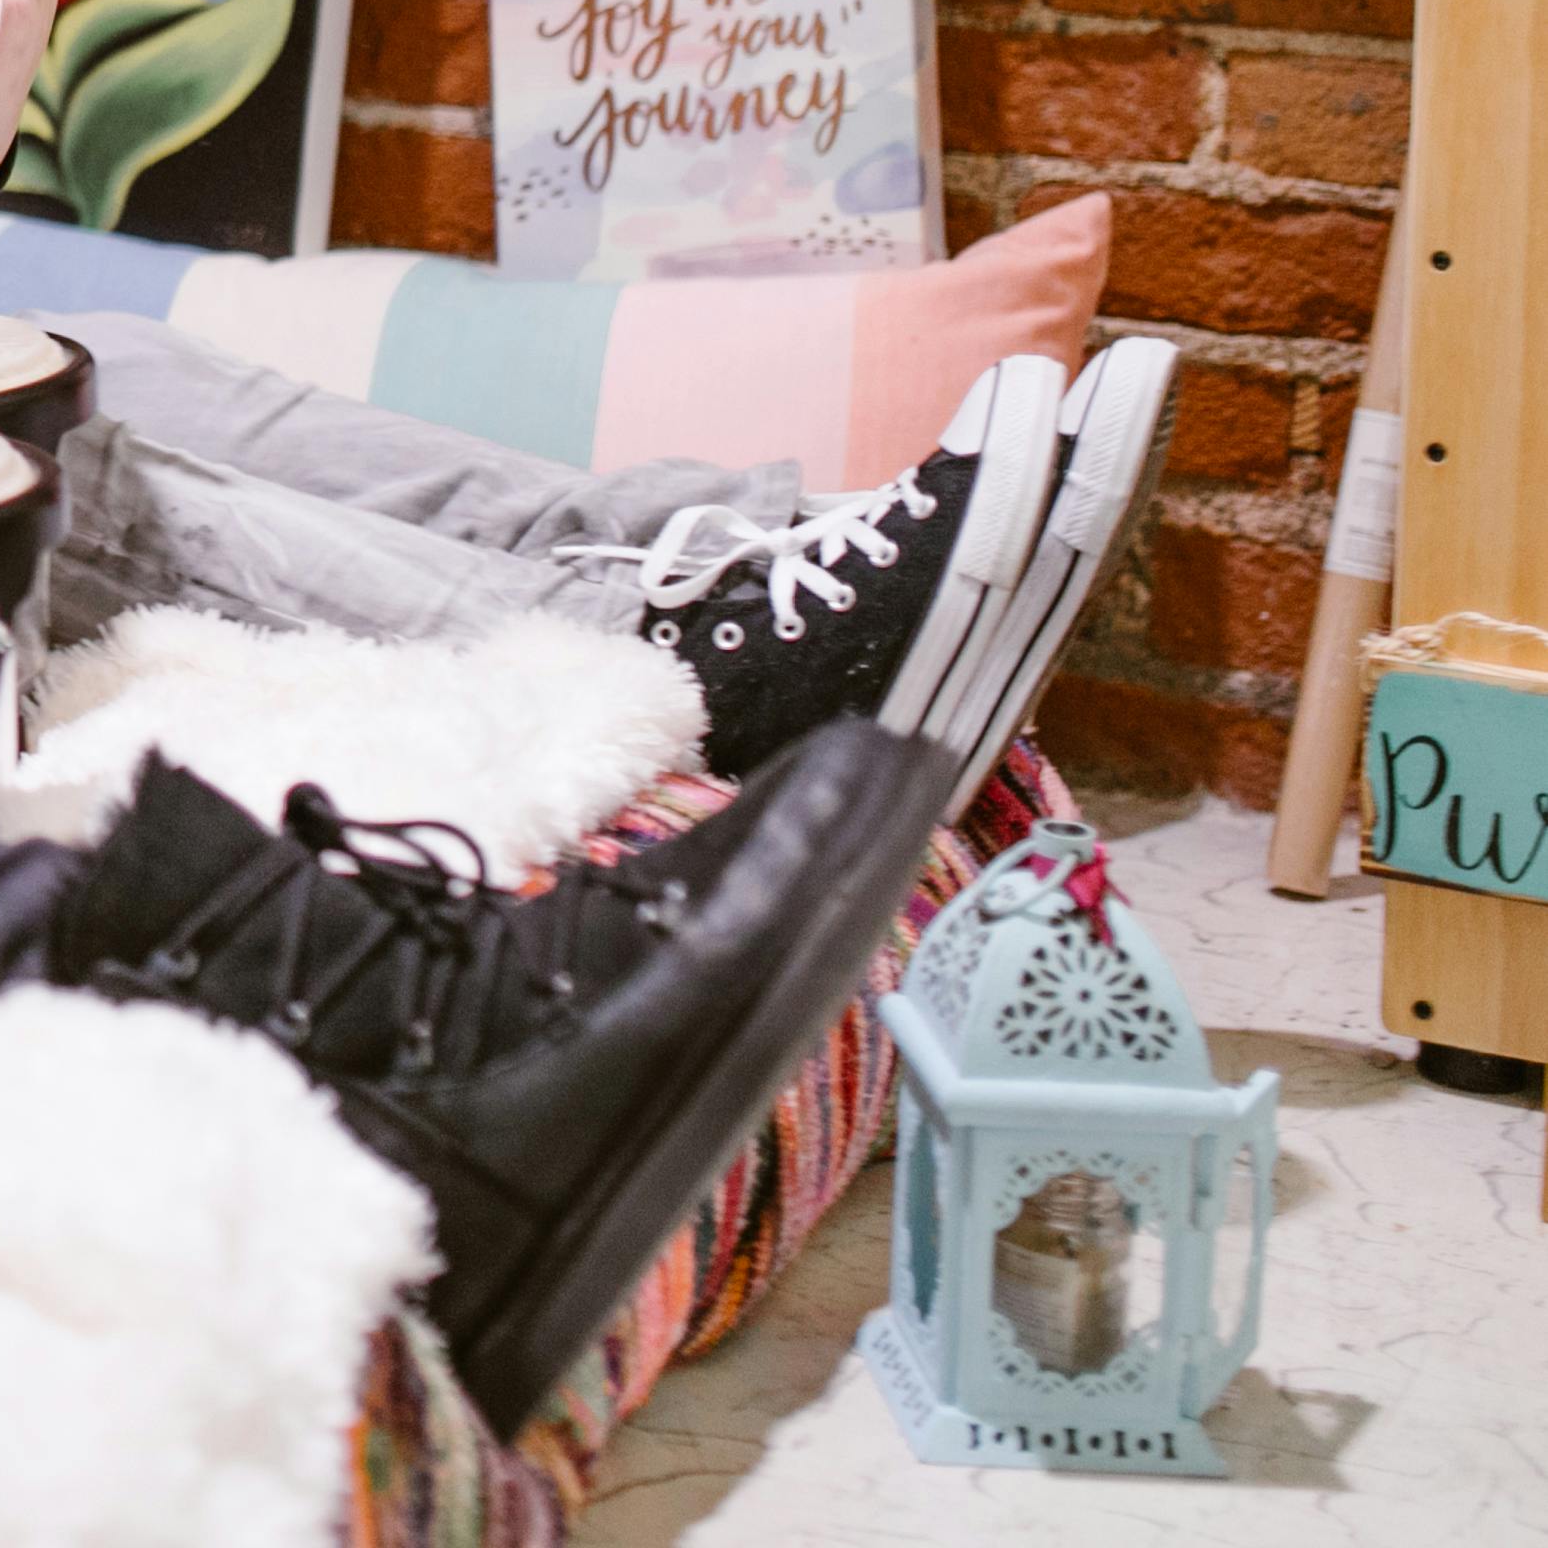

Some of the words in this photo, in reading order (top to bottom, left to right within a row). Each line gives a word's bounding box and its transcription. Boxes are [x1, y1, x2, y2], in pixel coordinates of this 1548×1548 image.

[703, 8, 836, 89] your
[553, 68, 858, 194] journey
[1371, 730, 1548, 884] Pu
